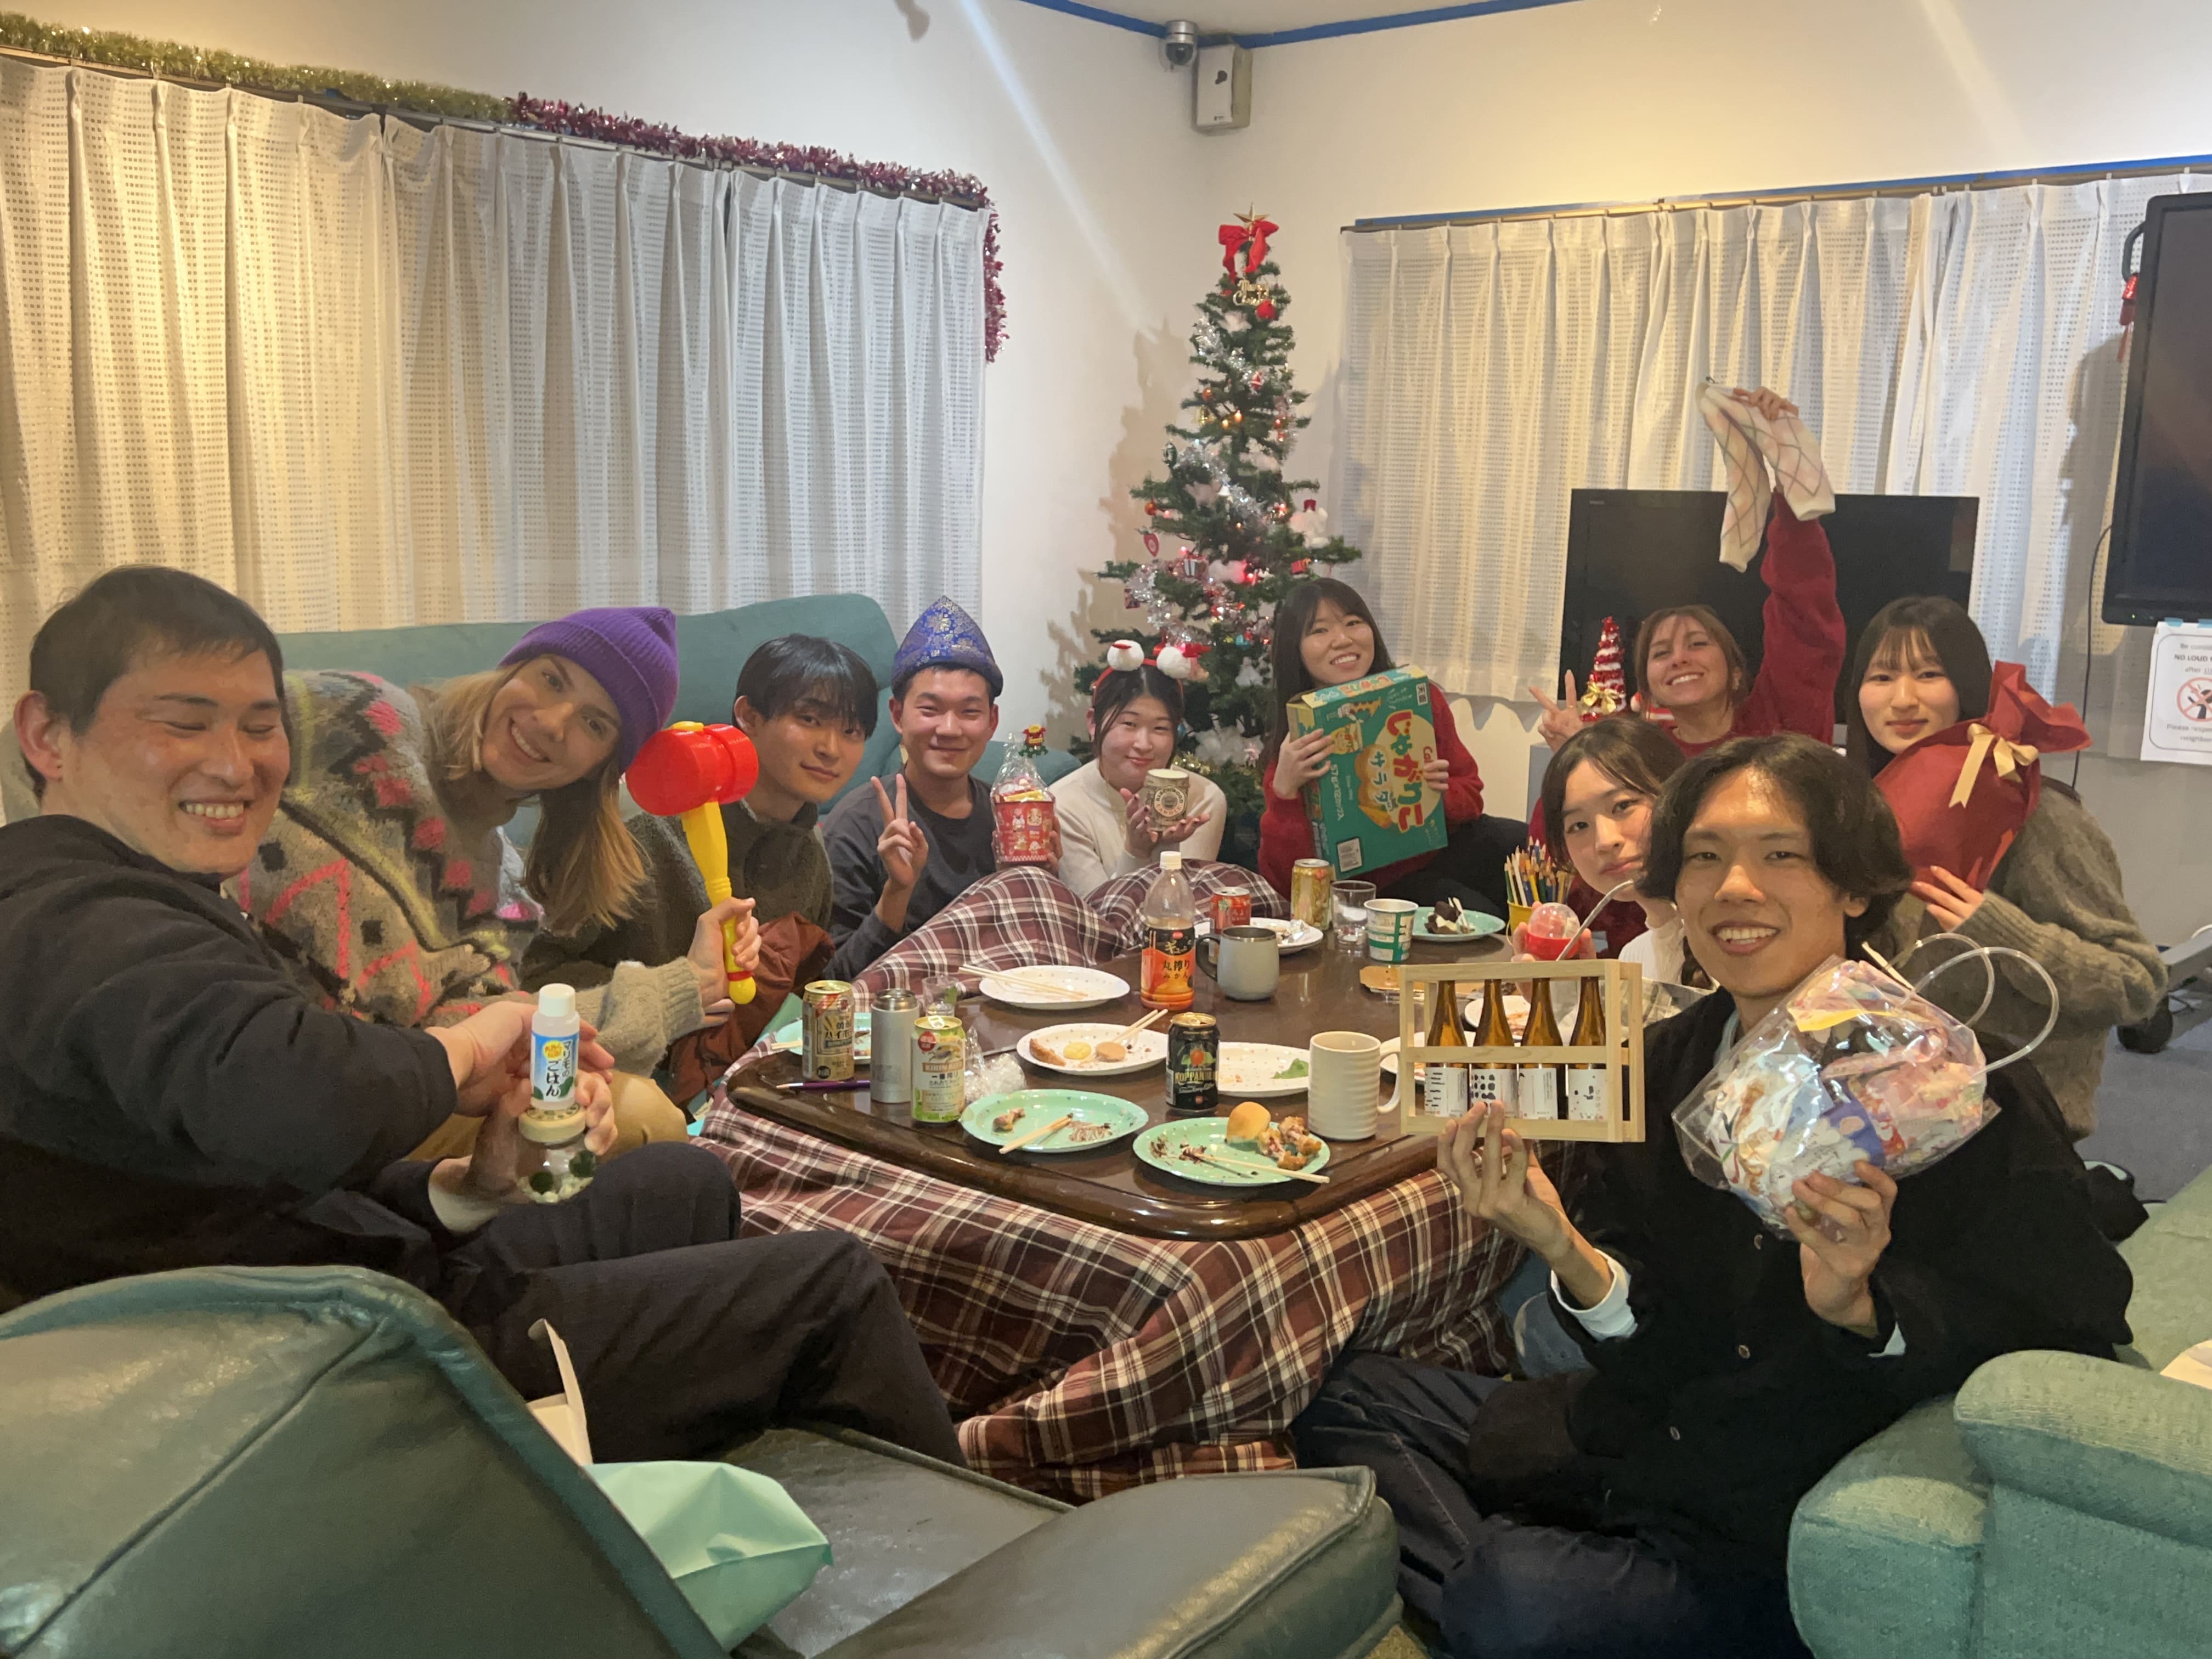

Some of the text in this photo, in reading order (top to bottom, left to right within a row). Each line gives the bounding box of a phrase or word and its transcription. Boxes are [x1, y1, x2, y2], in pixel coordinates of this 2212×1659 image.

[1370, 751, 1393, 811] サラダ
[1386, 710, 1423, 832] じゃがりこ
[1155, 803, 1182, 815] CANDLE
[546, 1059, 562, 1097] ごはん
